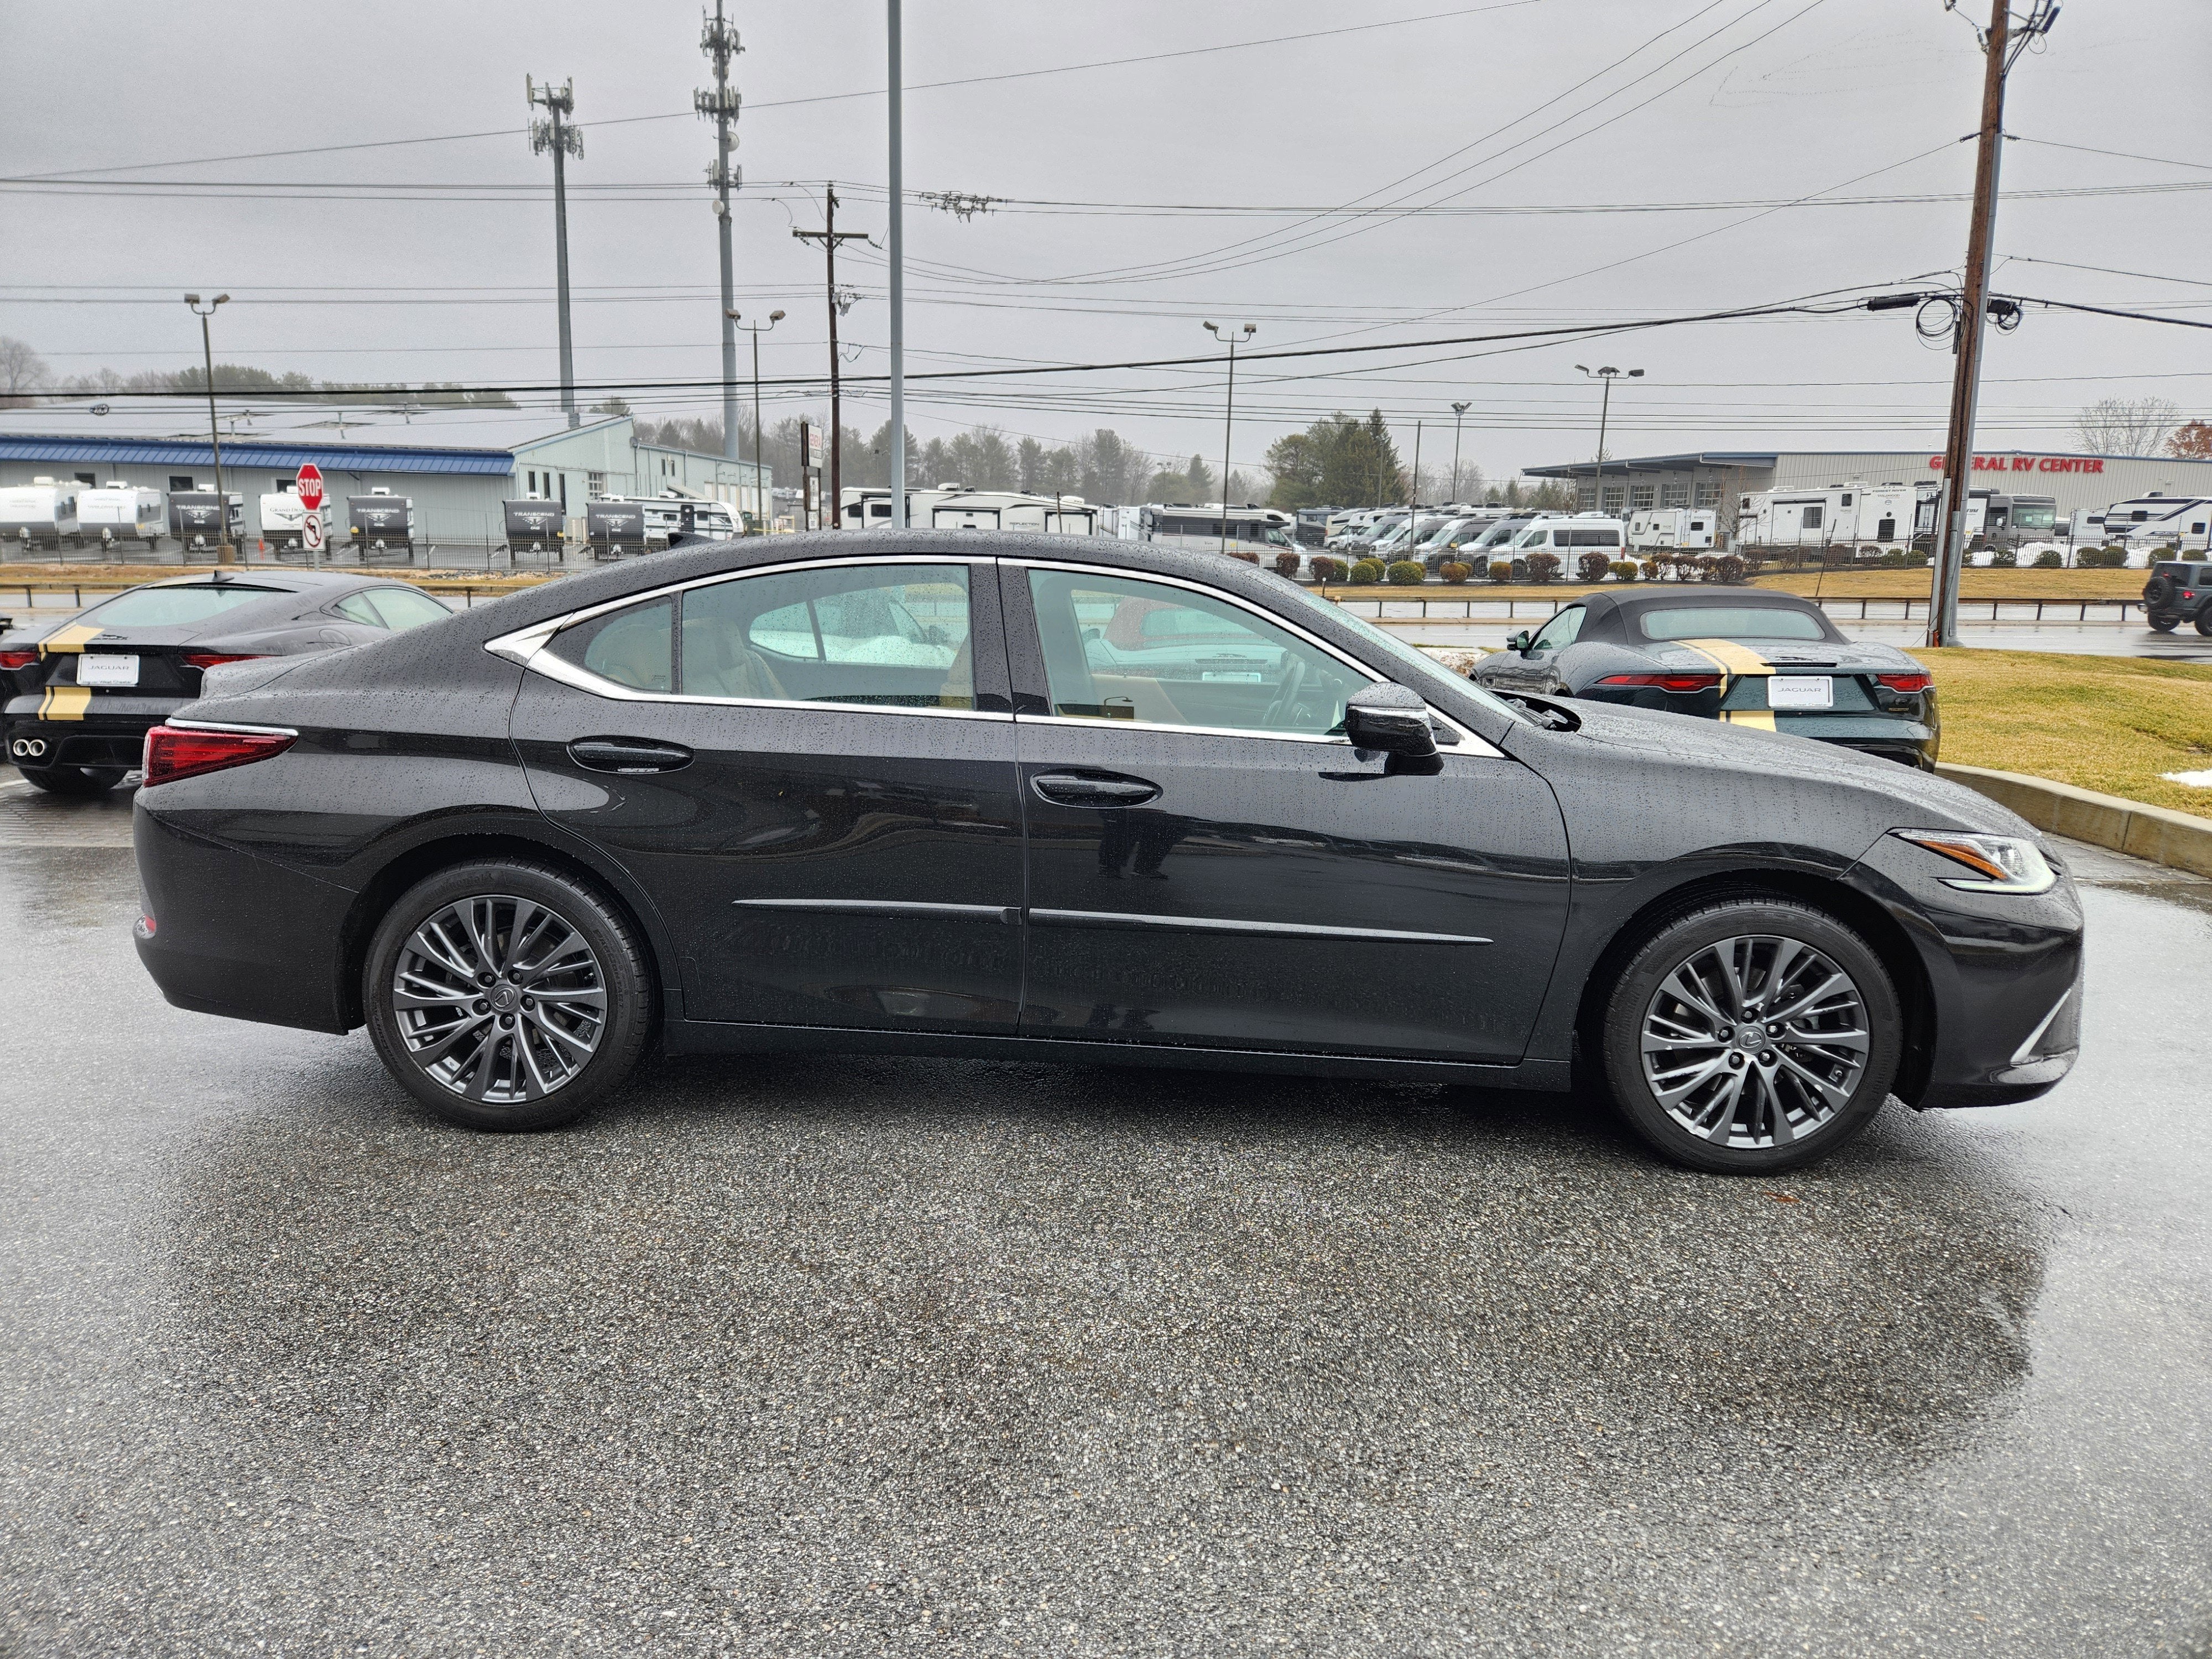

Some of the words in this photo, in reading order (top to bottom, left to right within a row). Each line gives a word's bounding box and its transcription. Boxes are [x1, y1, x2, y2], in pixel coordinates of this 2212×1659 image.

[1930, 455, 2007, 471] GRAL
[2012, 457, 2036, 471] RV
[2039, 458, 2104, 473] CENTER
[299, 478, 321, 497] STOP
